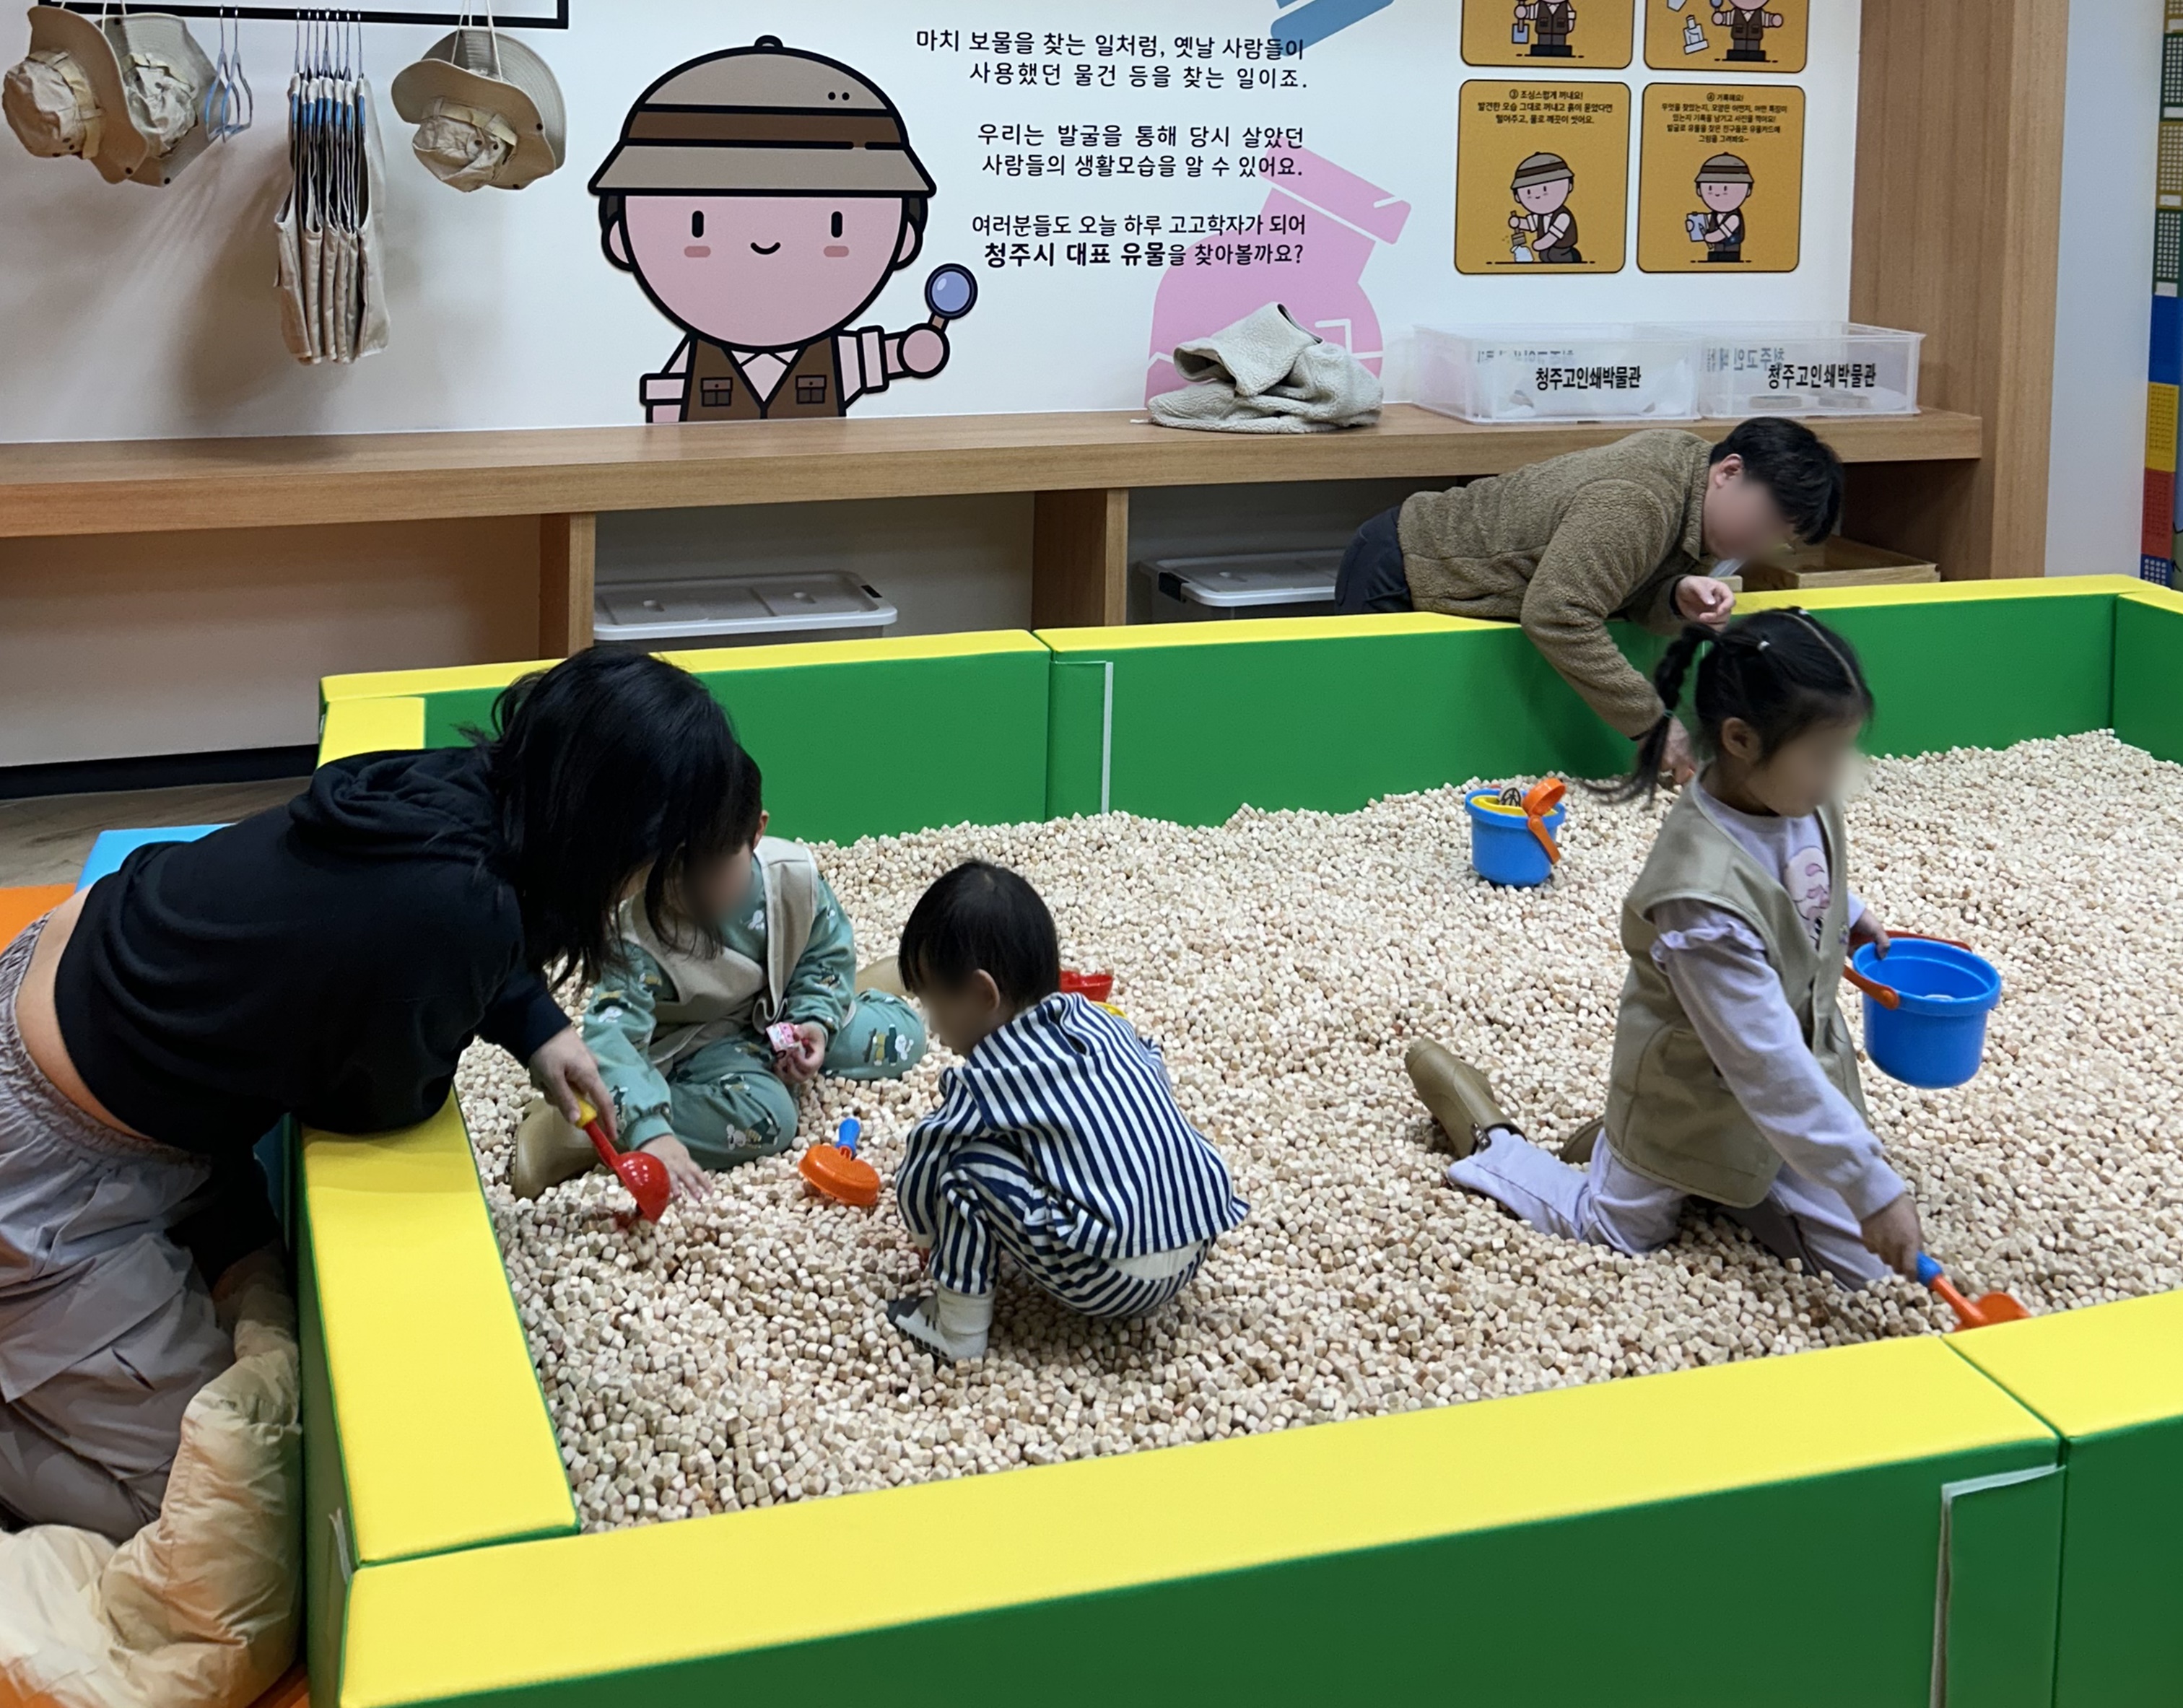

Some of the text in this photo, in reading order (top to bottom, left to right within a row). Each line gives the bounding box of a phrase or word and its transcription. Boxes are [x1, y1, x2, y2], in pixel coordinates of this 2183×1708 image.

[917, 30, 1304, 60] 마치 보물을 찾는 일처럼, 옛날 사람들이
[970, 62, 1307, 89] 사용했던 물건 등을 찾는 일이죠.
[978, 124, 1302, 149] 우리는 발굴을 통해 당시 살았던
[982, 154, 1302, 177] 사람들의 생활모습을 알 수 있어요.
[972, 214, 1304, 237] 여러분들도 오늘 하루 고고학자가 되어
[985, 243, 1303, 268] 청주시 대표 유물을 찾아볼까요?
[1536, 366, 1641, 391] 청주고인쇄박물관
[1768, 363, 1876, 389] 청주고인쇄박물관
